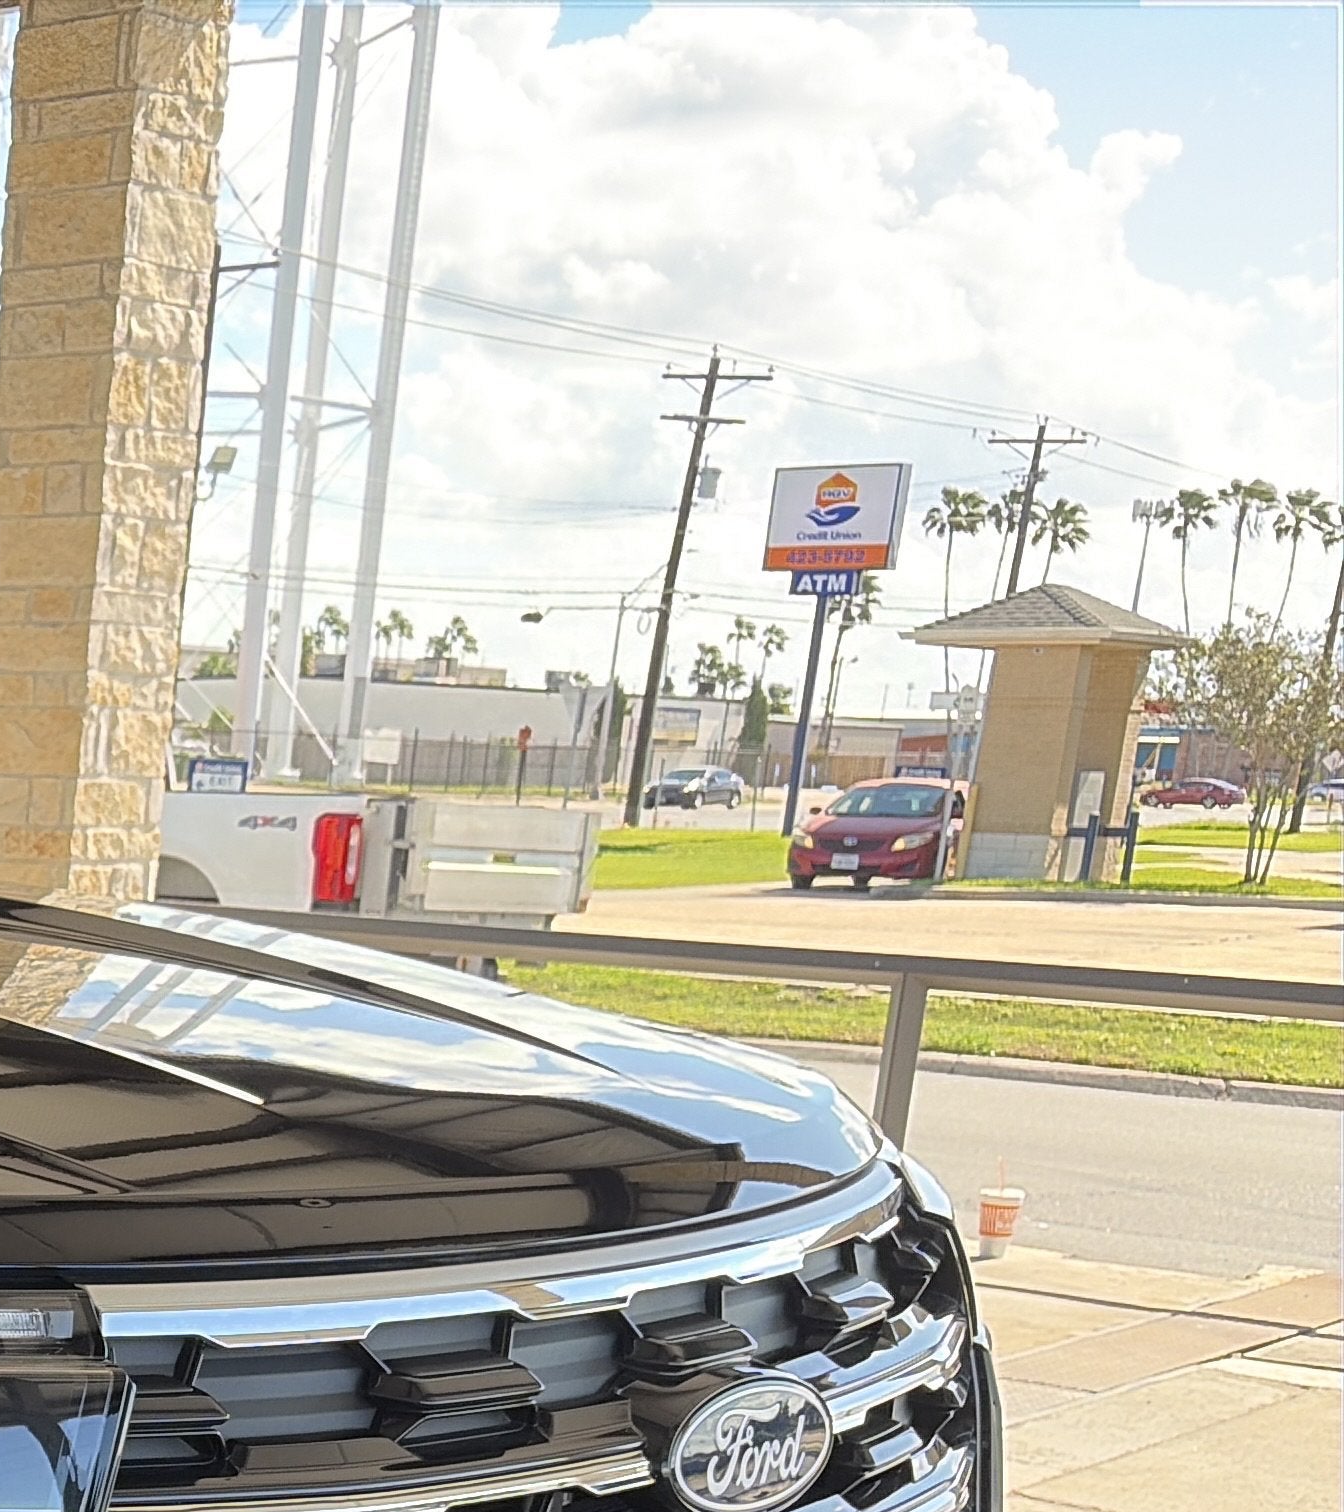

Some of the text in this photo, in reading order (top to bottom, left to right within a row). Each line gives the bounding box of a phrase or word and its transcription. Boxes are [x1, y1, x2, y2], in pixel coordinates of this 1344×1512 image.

[830, 530, 862, 540] Union
[796, 573, 847, 593] ATM
[706, 1402, 806, 1497] Ford
